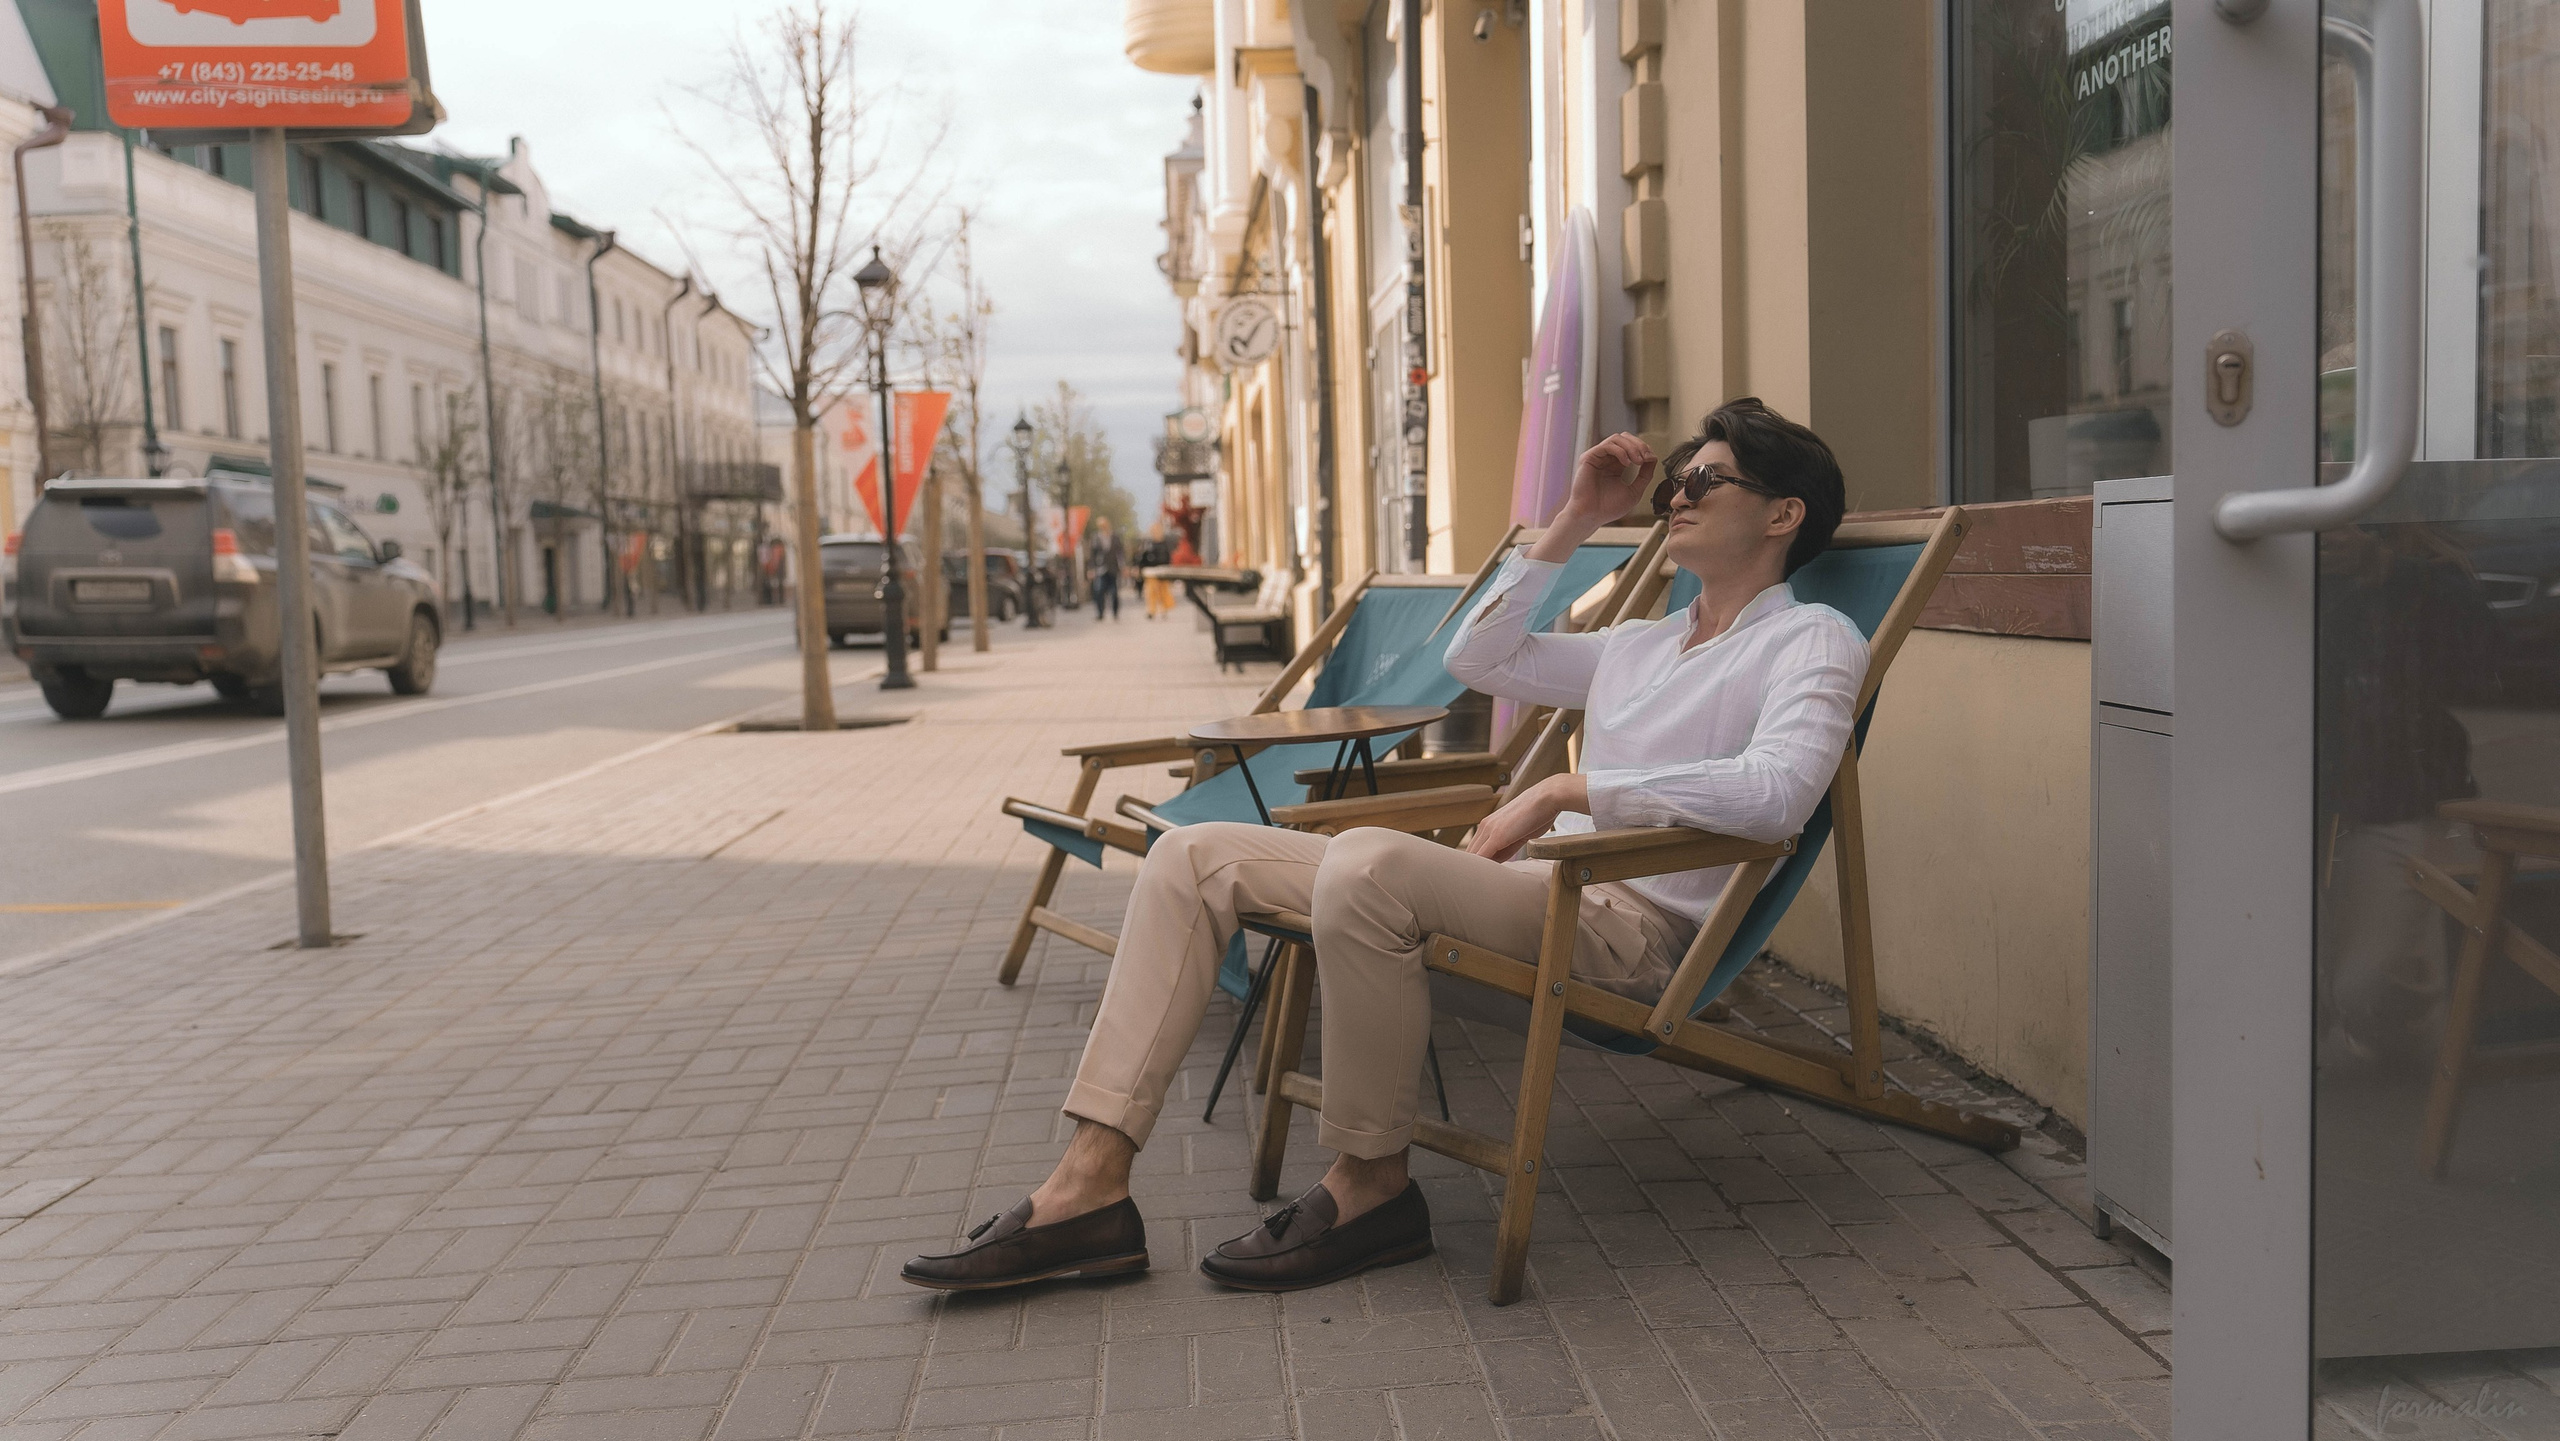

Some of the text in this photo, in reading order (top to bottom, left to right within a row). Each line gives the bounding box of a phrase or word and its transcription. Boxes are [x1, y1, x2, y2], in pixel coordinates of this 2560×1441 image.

[2095, 0, 2137, 40] LIKE
[158, 62, 355, 85] +7 (843) 225-25-48
[2078, 25, 2172, 101] ANOTHER
[134, 86, 384, 108] www.city-sightseeing.ru
